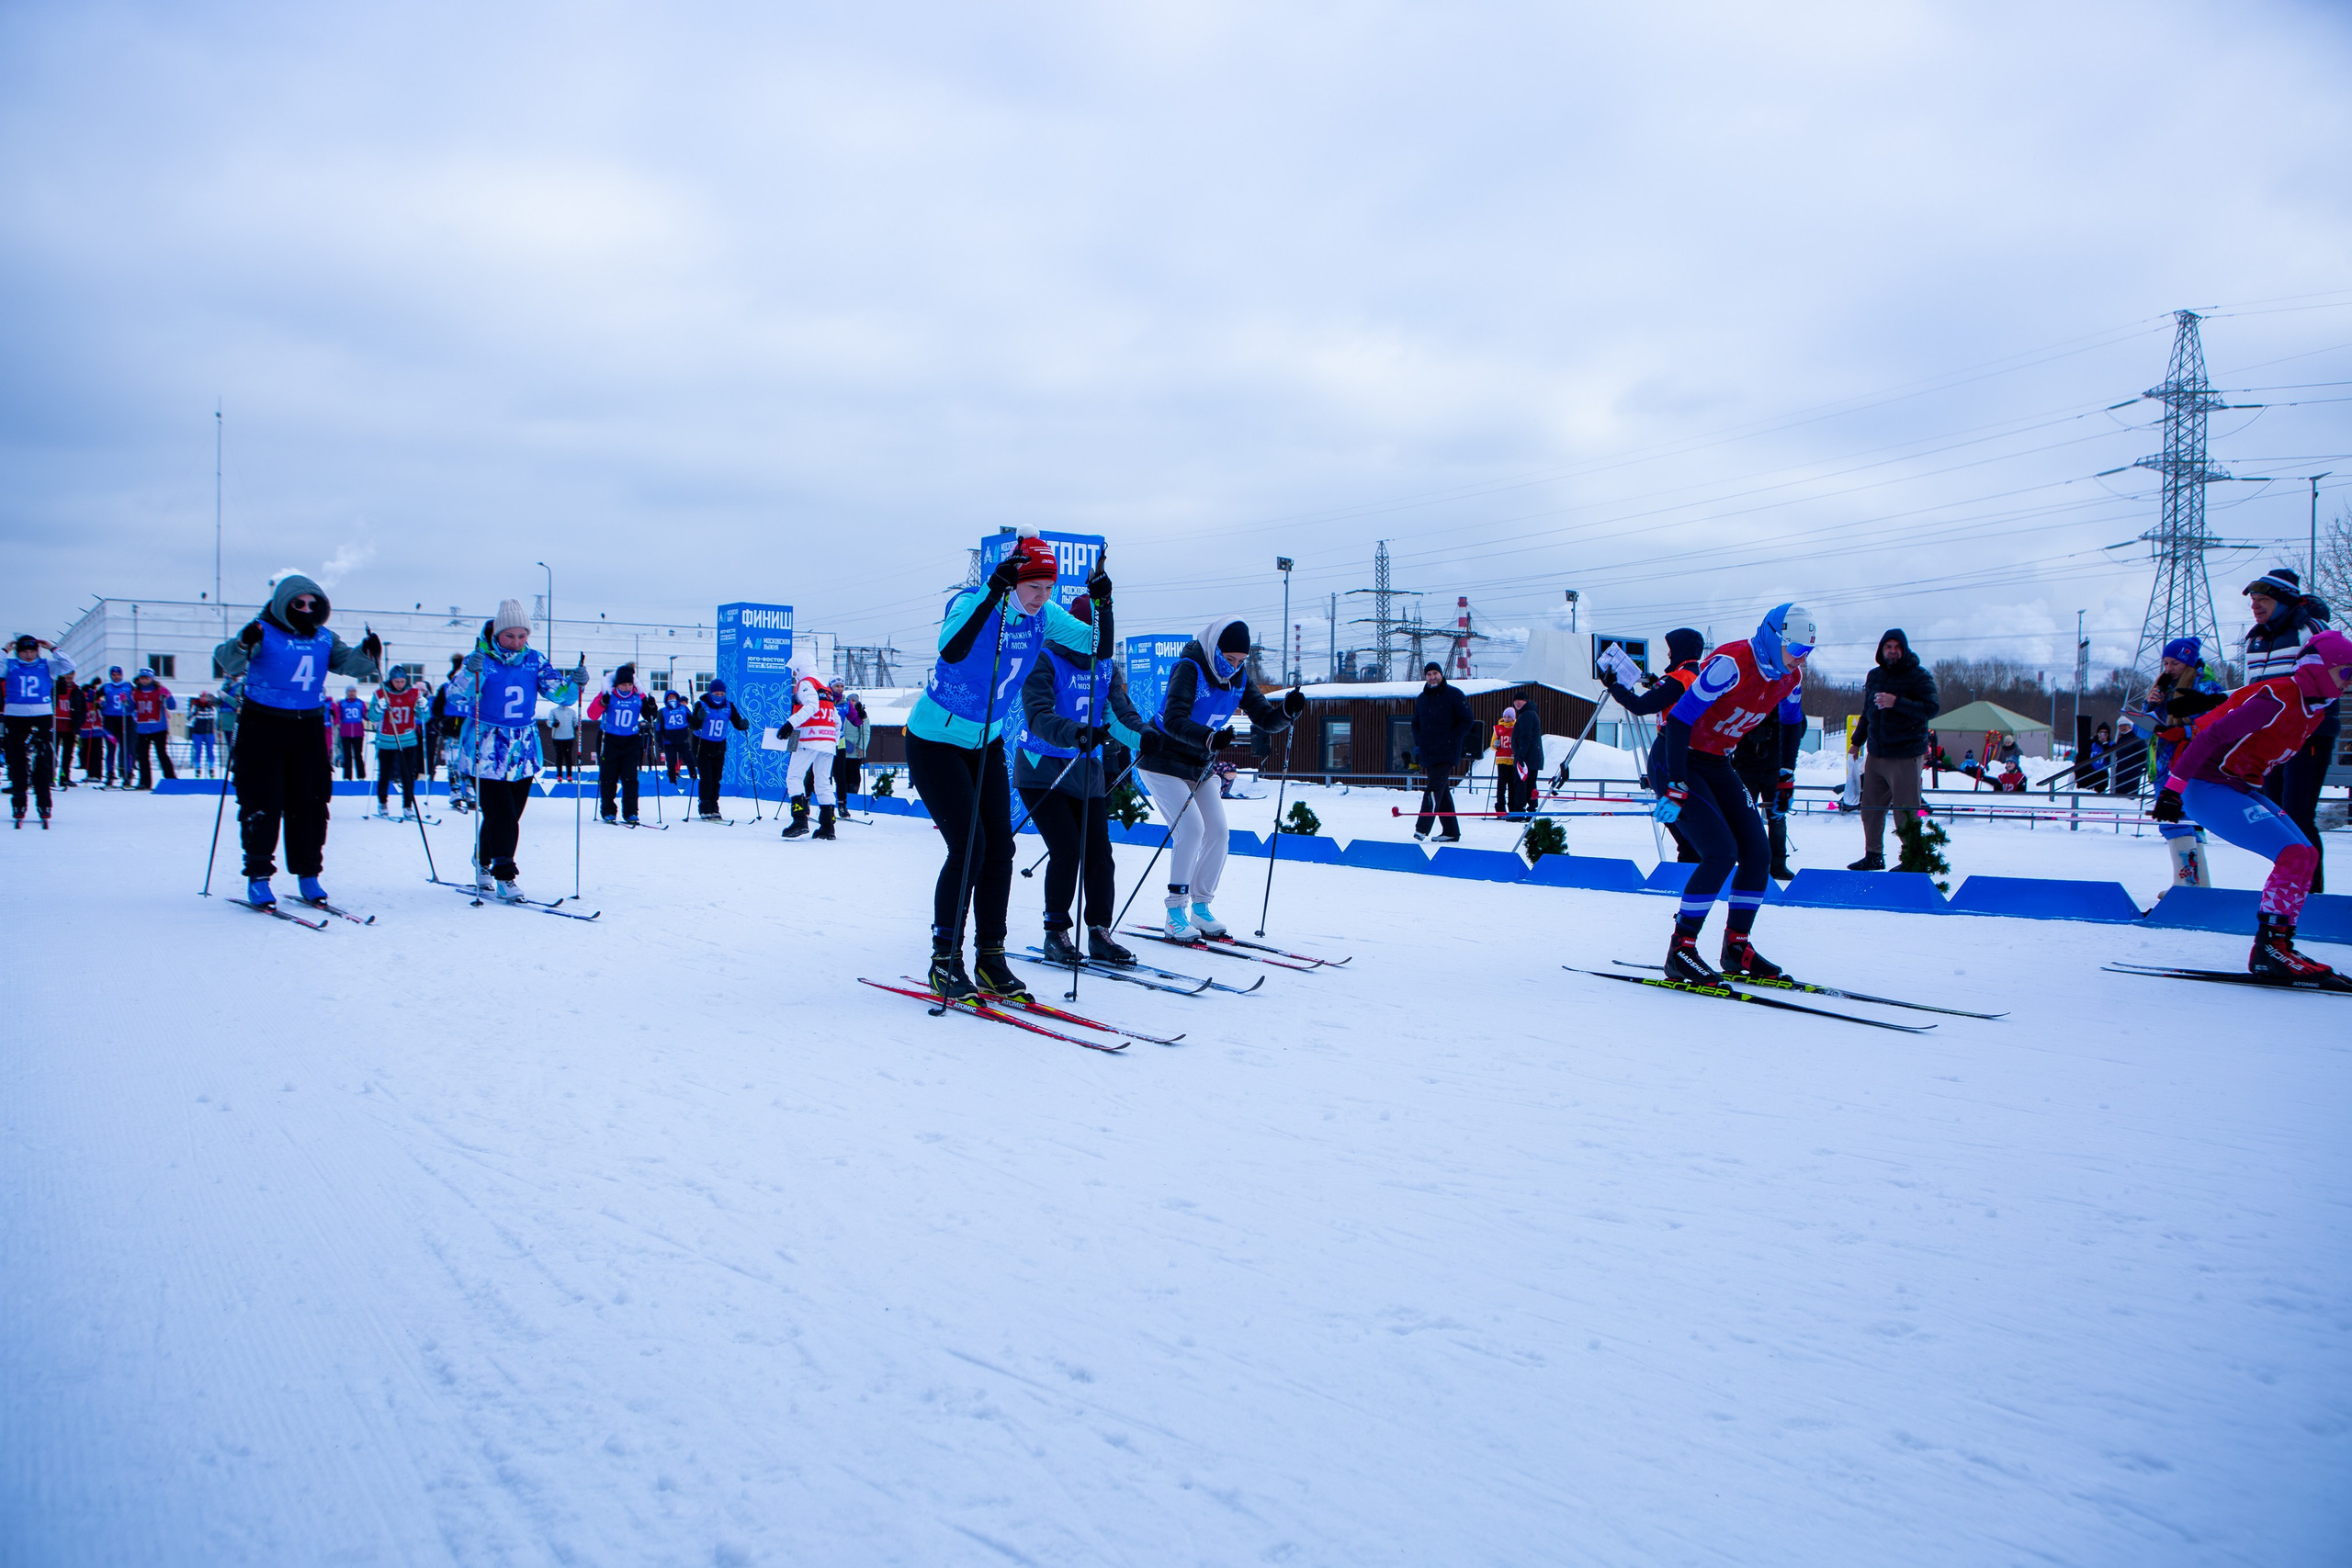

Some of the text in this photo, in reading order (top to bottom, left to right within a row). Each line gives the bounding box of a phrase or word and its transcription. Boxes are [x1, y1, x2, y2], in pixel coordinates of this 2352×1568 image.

[1042, 539, 1100, 576] ТАРТ
[741, 608, 792, 629] ФИНИШ
[1092, 609, 1101, 653] NORDWAY
[289, 655, 317, 691] 4
[997, 658, 1023, 700] 7
[19, 675, 40, 697] 12
[503, 685, 525, 718] 2
[345, 708, 358, 718] 20
[615, 709, 632, 728] 10
[668, 714, 684, 726] 43
[708, 719, 724, 737] 19
[1677, 951, 1711, 976] MADSHUS
[2264, 943, 2305, 971] alpina
[1642, 978, 1731, 998] FISCHER
[953, 1001, 978, 1013] ATOMIC
[1001, 998, 1026, 1010] ATOMIC
